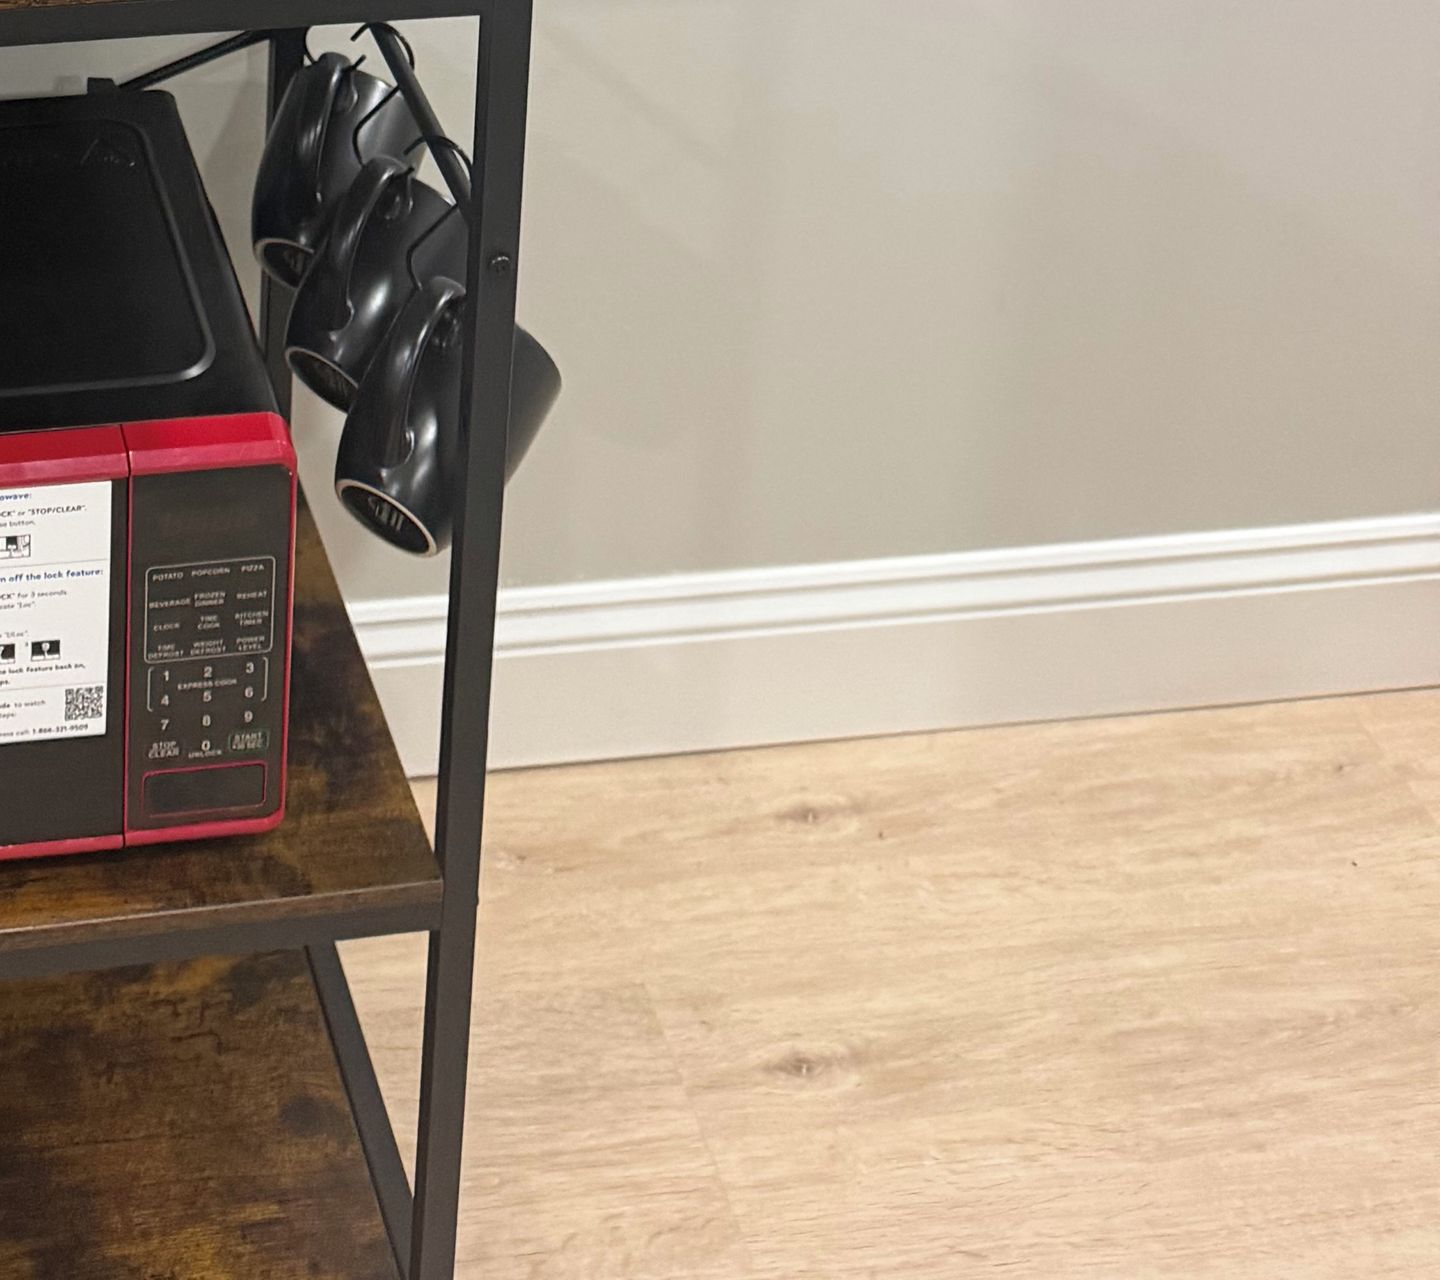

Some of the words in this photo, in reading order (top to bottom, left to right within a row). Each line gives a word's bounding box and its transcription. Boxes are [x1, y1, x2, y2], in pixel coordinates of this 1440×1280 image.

[8, 573, 24, 583] off
[26, 573, 42, 581] the
[43, 571, 63, 580] lock
[66, 569, 104, 578] feature:
[152, 571, 184, 581] POTATO
[191, 567, 231, 577] POPCORN
[241, 564, 265, 573] PIZZA
[148, 597, 191, 609] BEVERAGE
[194, 591, 226, 600] FROZEN
[236, 590, 268, 600] REHEAT
[194, 599, 225, 608] DINNER
[153, 623, 180, 632] CLOCK
[197, 622, 220, 630] COOK
[163, 669, 170, 681] 1
[203, 665, 213, 678] 2
[245, 662, 255, 674] 3
[177, 680, 214, 691] EXPRESS
[214, 678, 238, 687] COOK
[160, 694, 170, 706] 4
[203, 690, 212, 702] 5
[244, 686, 254, 698] 6
[160, 718, 170, 731] 7
[202, 714, 211, 727] 8
[244, 710, 253, 723] 9
[152, 740, 177, 751] STOP
[201, 739, 211, 752] 0
[148, 747, 180, 759] CLEAR
[188, 749, 222, 759] UNLOCK
